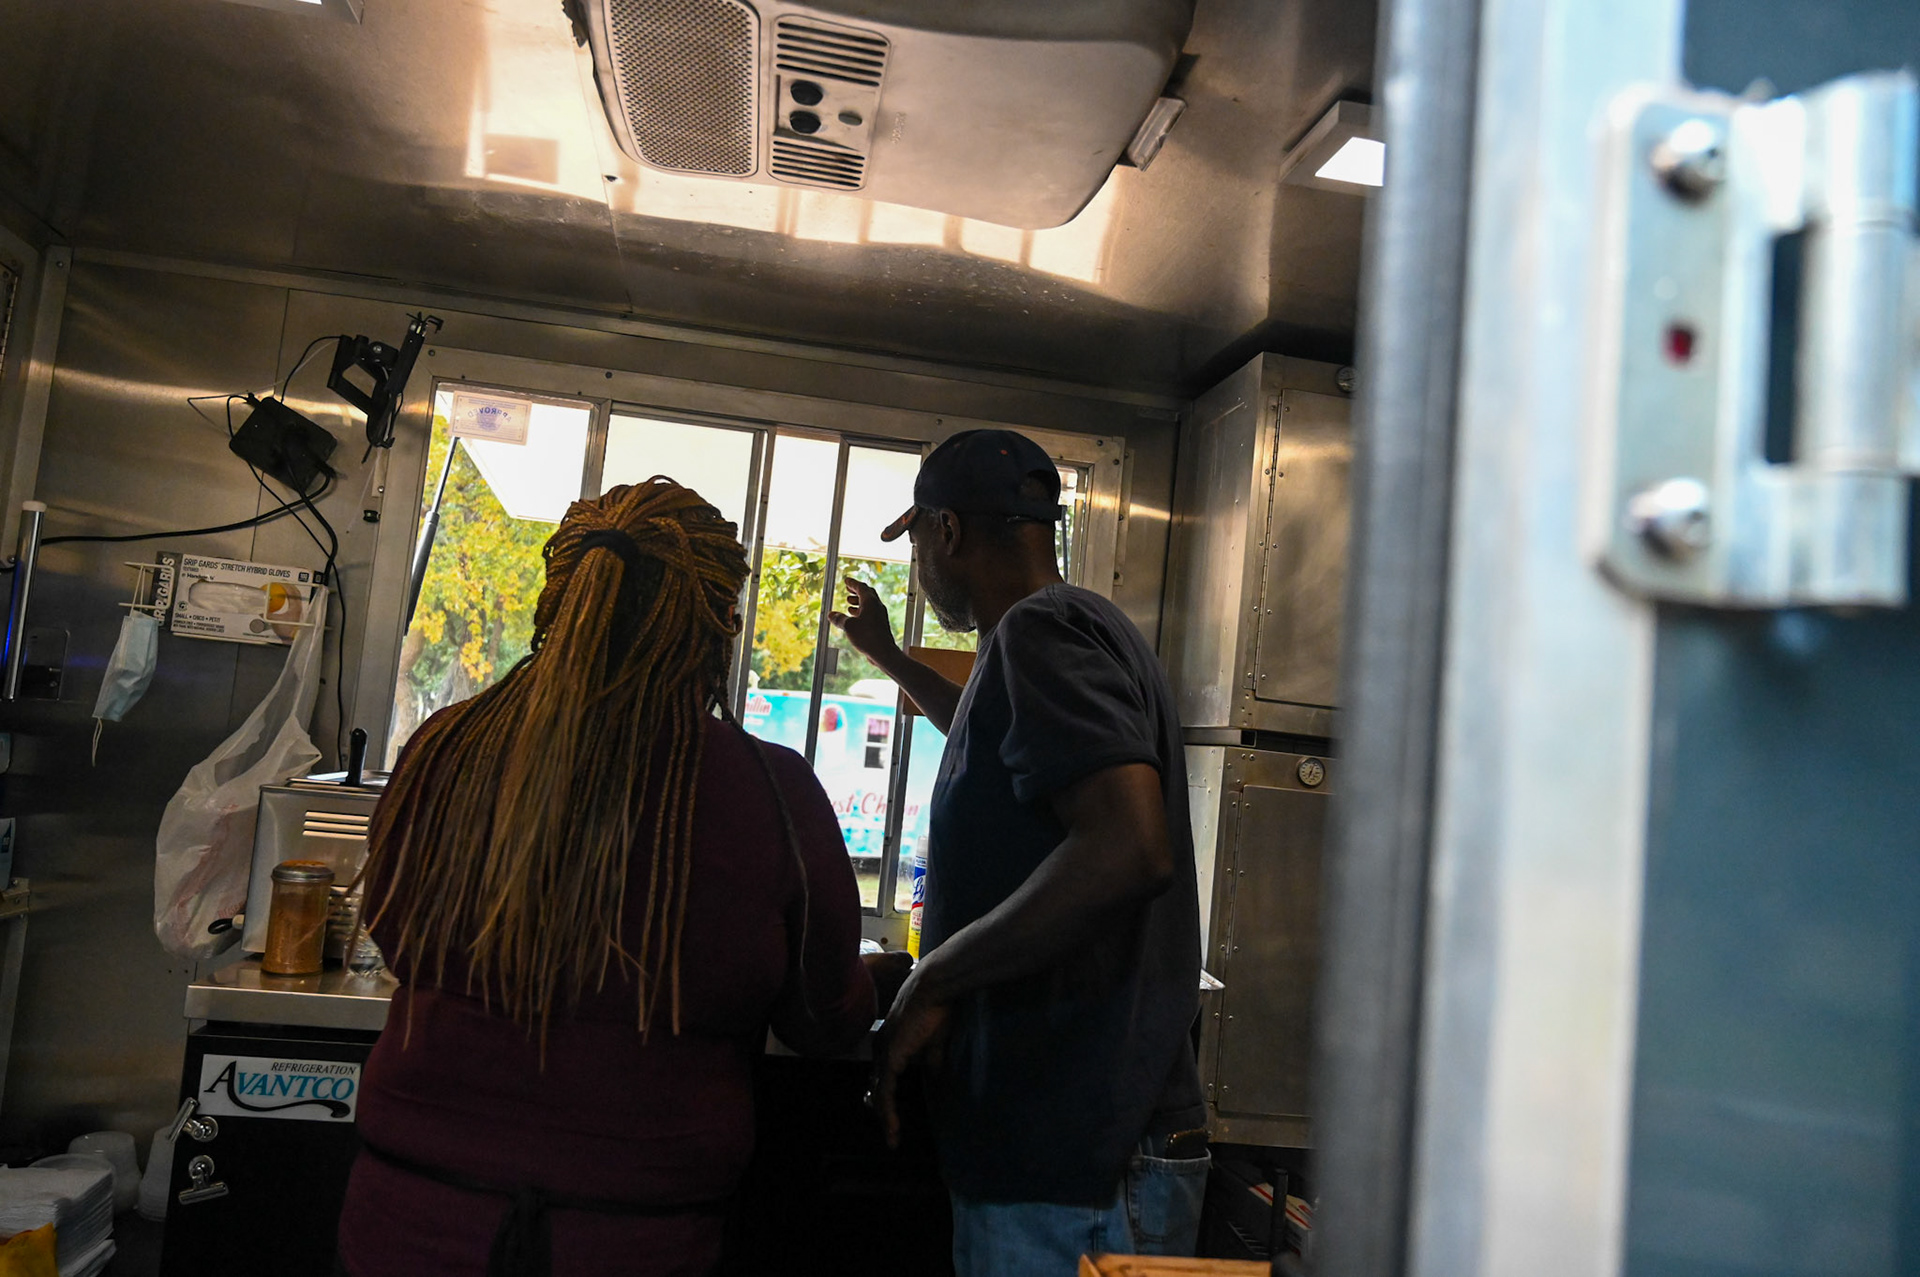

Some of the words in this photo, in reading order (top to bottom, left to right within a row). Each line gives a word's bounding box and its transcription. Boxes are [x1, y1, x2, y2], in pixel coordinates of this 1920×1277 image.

[183, 558, 198, 567] GRIP
[220, 563, 246, 573] STRETCH
[246, 566, 268, 576] HYBRID
[268, 568, 291, 578] GLOVES
[271, 1061, 357, 1076] REFRIGERATION
[203, 1060, 355, 1112] AVANTCO
